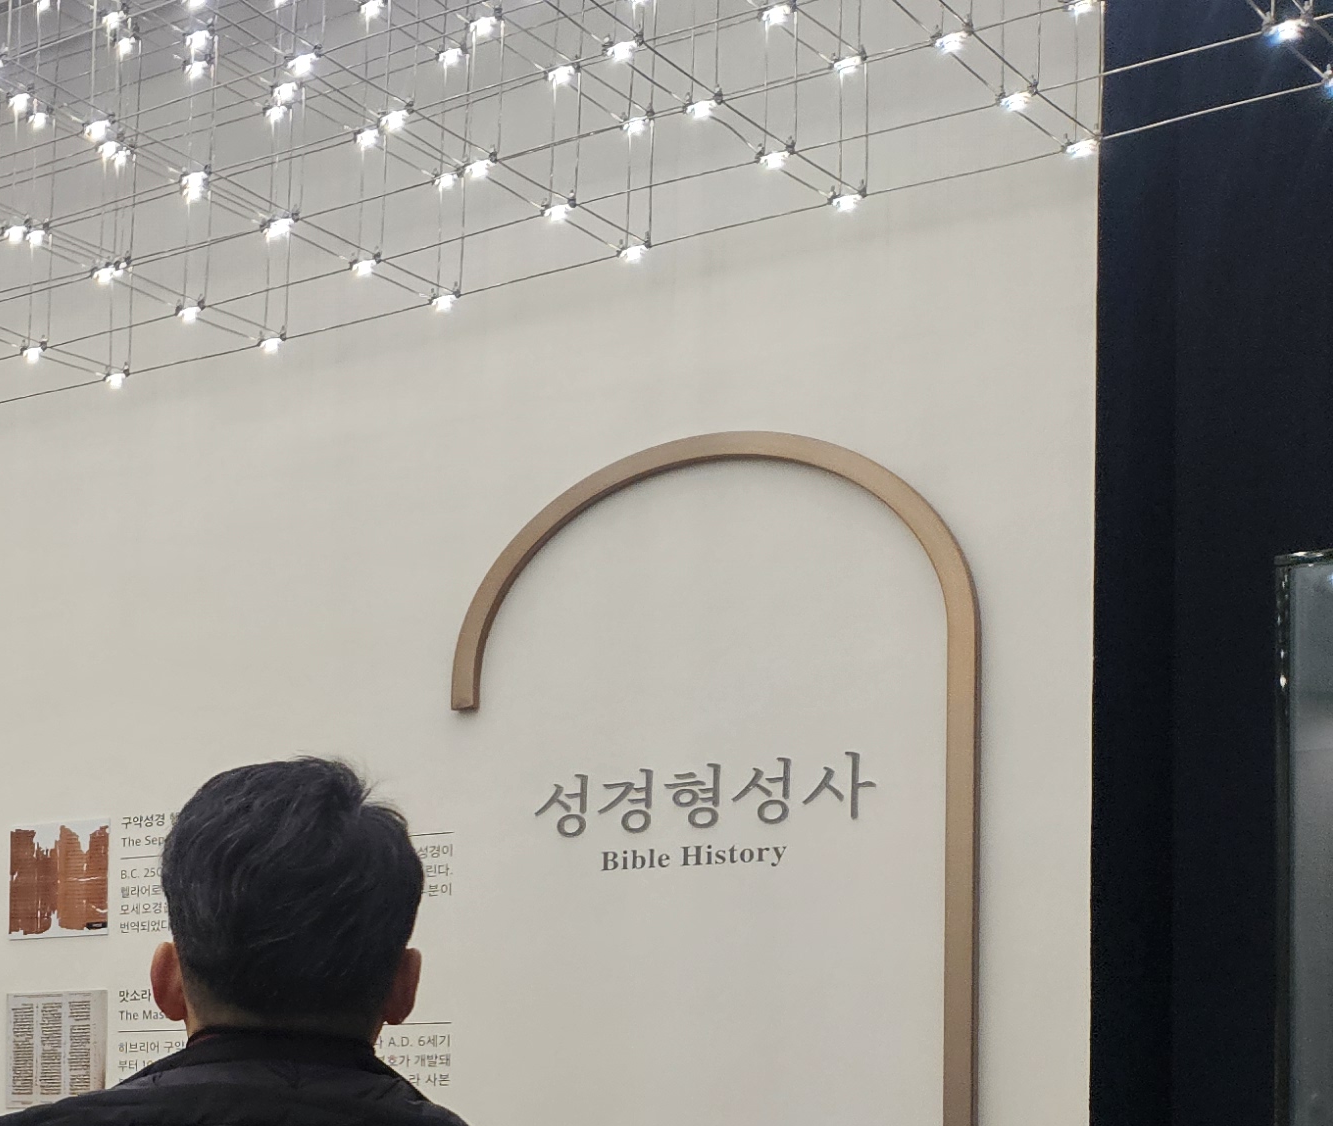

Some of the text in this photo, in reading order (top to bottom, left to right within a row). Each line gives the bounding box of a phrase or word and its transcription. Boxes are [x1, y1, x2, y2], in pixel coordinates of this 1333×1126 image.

[534, 751, 877, 839] 성경형성사
[121, 813, 165, 830] 구약성경
[120, 836, 142, 848] The
[601, 843, 788, 872] Bible History
[118, 988, 152, 1003] 맛소라
[118, 1010, 139, 1021] The
[118, 1041, 160, 1054] 히브리어
[417, 1034, 451, 1048] 6세기
[117, 1059, 139, 1074] 부터
[414, 1053, 451, 1068] 개발돼
[425, 1073, 451, 1087] 사본
